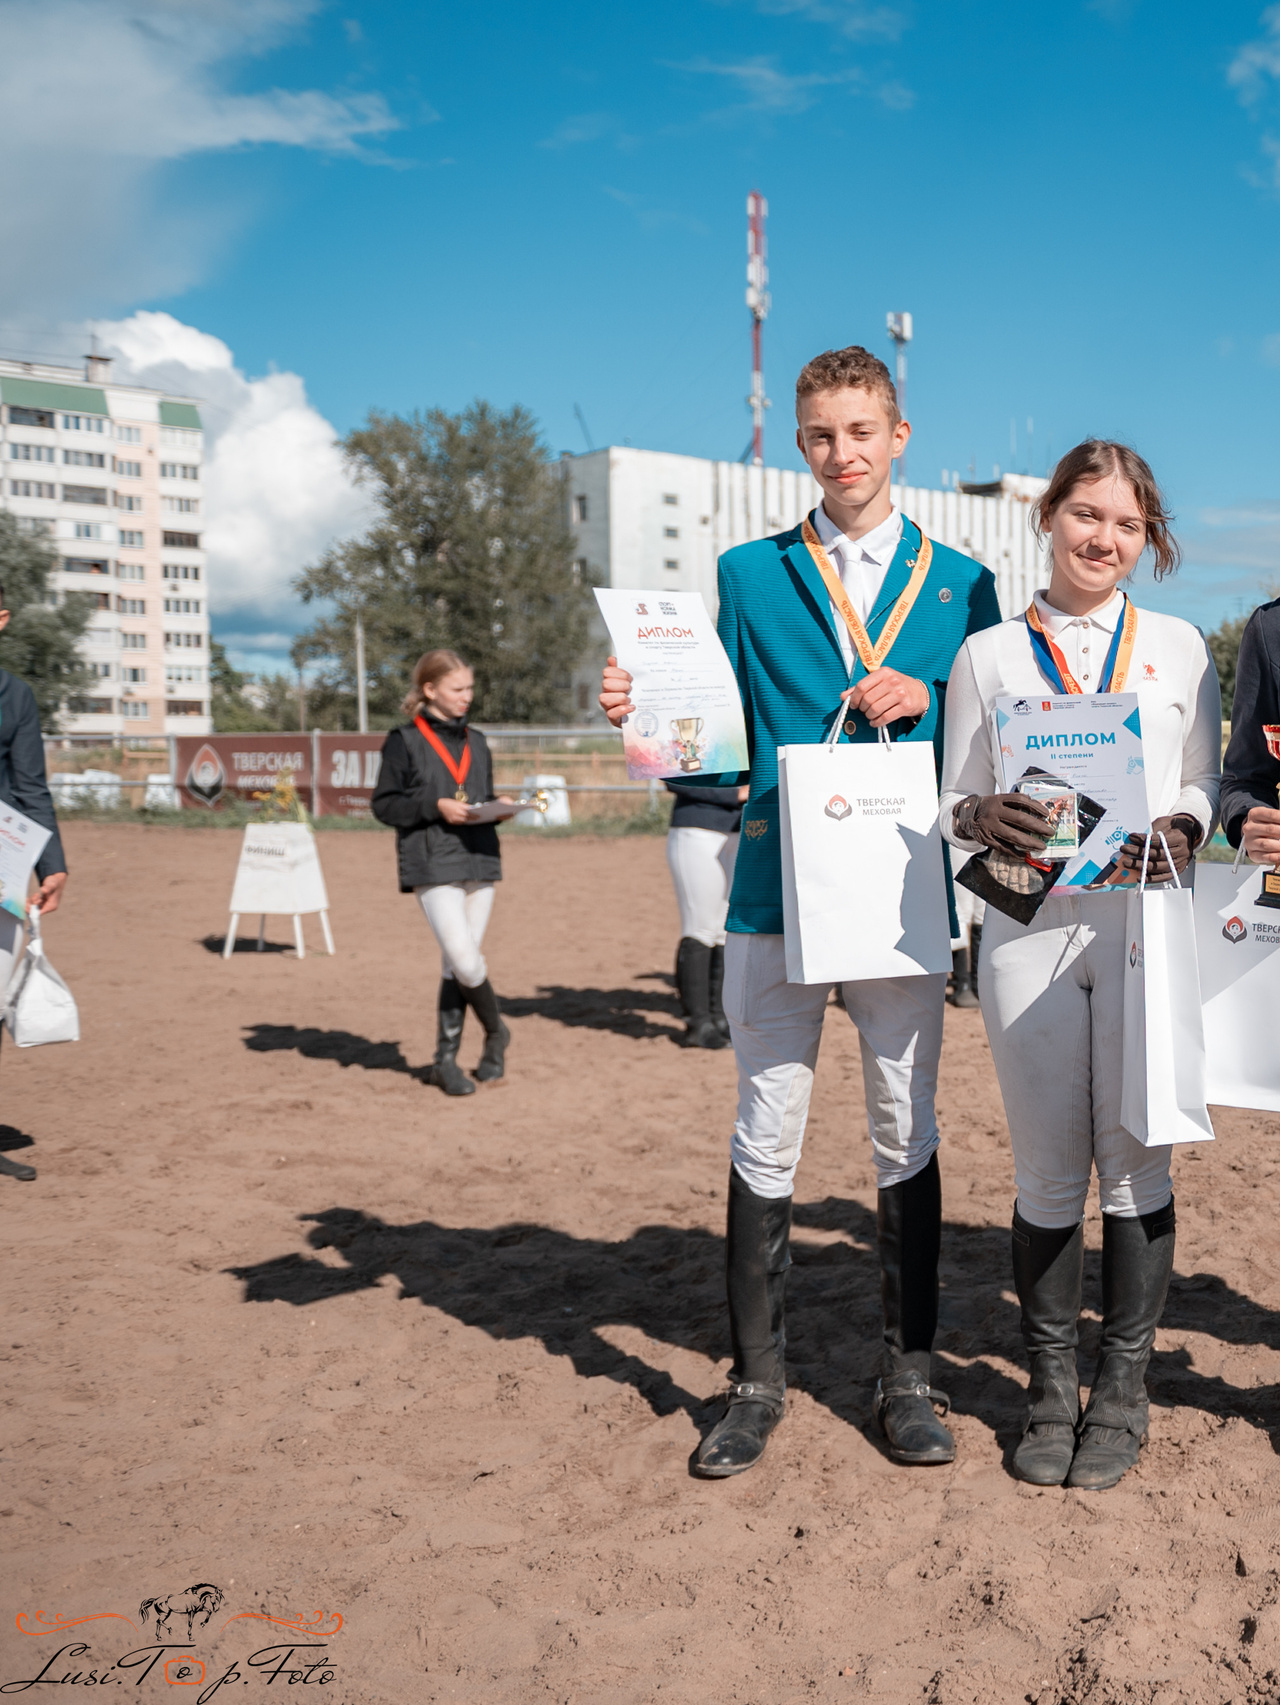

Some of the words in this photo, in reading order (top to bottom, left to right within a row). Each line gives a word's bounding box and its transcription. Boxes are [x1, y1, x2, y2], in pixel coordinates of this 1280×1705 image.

[841, 600, 861, 631] ОБЛАСТЬ
[887, 600, 909, 635] ТВЕРСКАЯ
[637, 626, 694, 639] ДИПЛОМ
[854, 628, 874, 666] ТВЕРСКАЯ
[874, 632, 895, 662] ОБЛАСТЬ
[1025, 732, 1116, 750] ДИПЛОМ
[231, 751, 305, 772] ТВЕРСКАЯ
[331, 750, 361, 788] ЗА
[856, 797, 906, 807] ТВЕРСКАЯ
[862, 807, 902, 816] МЕХОВАЯ
[244, 845, 285, 857] ФИНИШ
